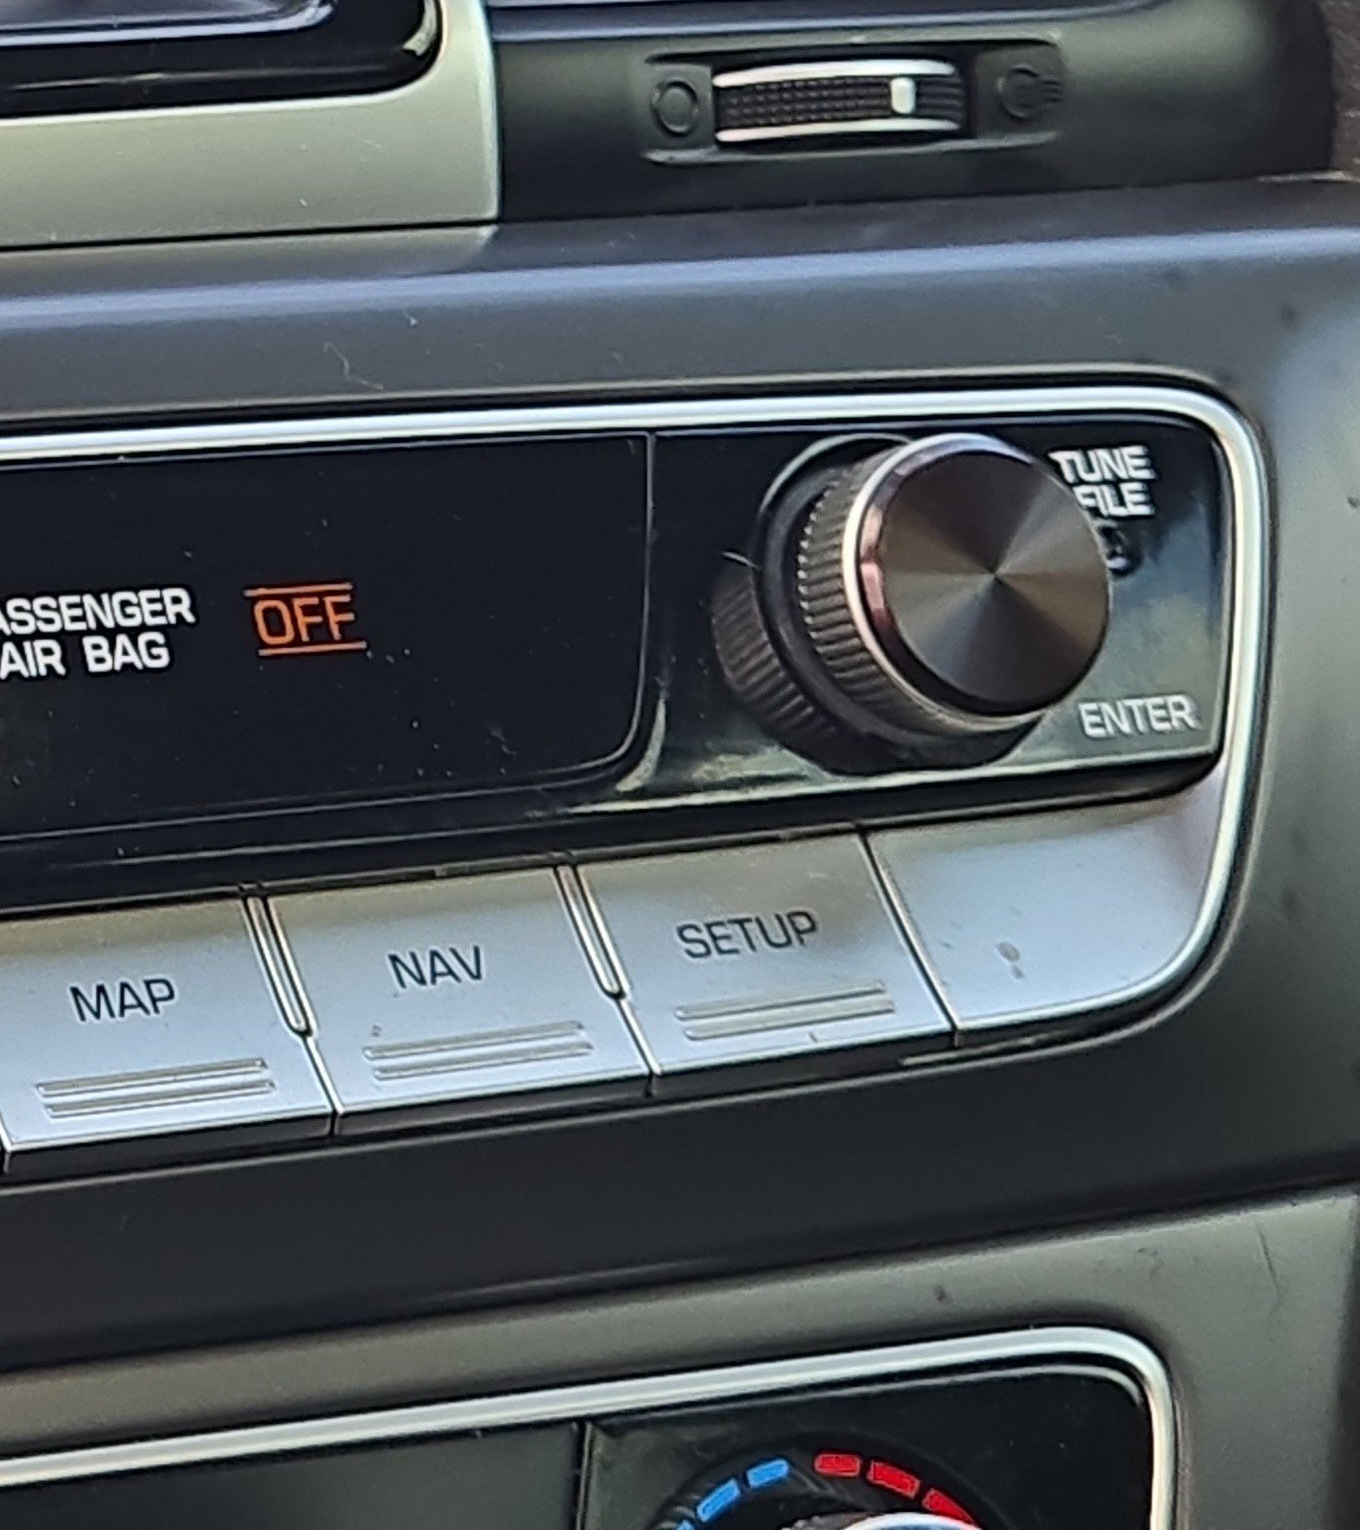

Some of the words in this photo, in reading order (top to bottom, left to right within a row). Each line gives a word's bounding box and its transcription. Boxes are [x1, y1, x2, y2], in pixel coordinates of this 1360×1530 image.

[1046, 443, 1159, 485] TUNE
[252, 593, 356, 646] OFF
[82, 631, 171, 674] BAG
[1079, 692, 1200, 738] ENTER
[674, 907, 820, 960] SETUP
[388, 943, 486, 990] NAV
[69, 977, 176, 1023] MAP
